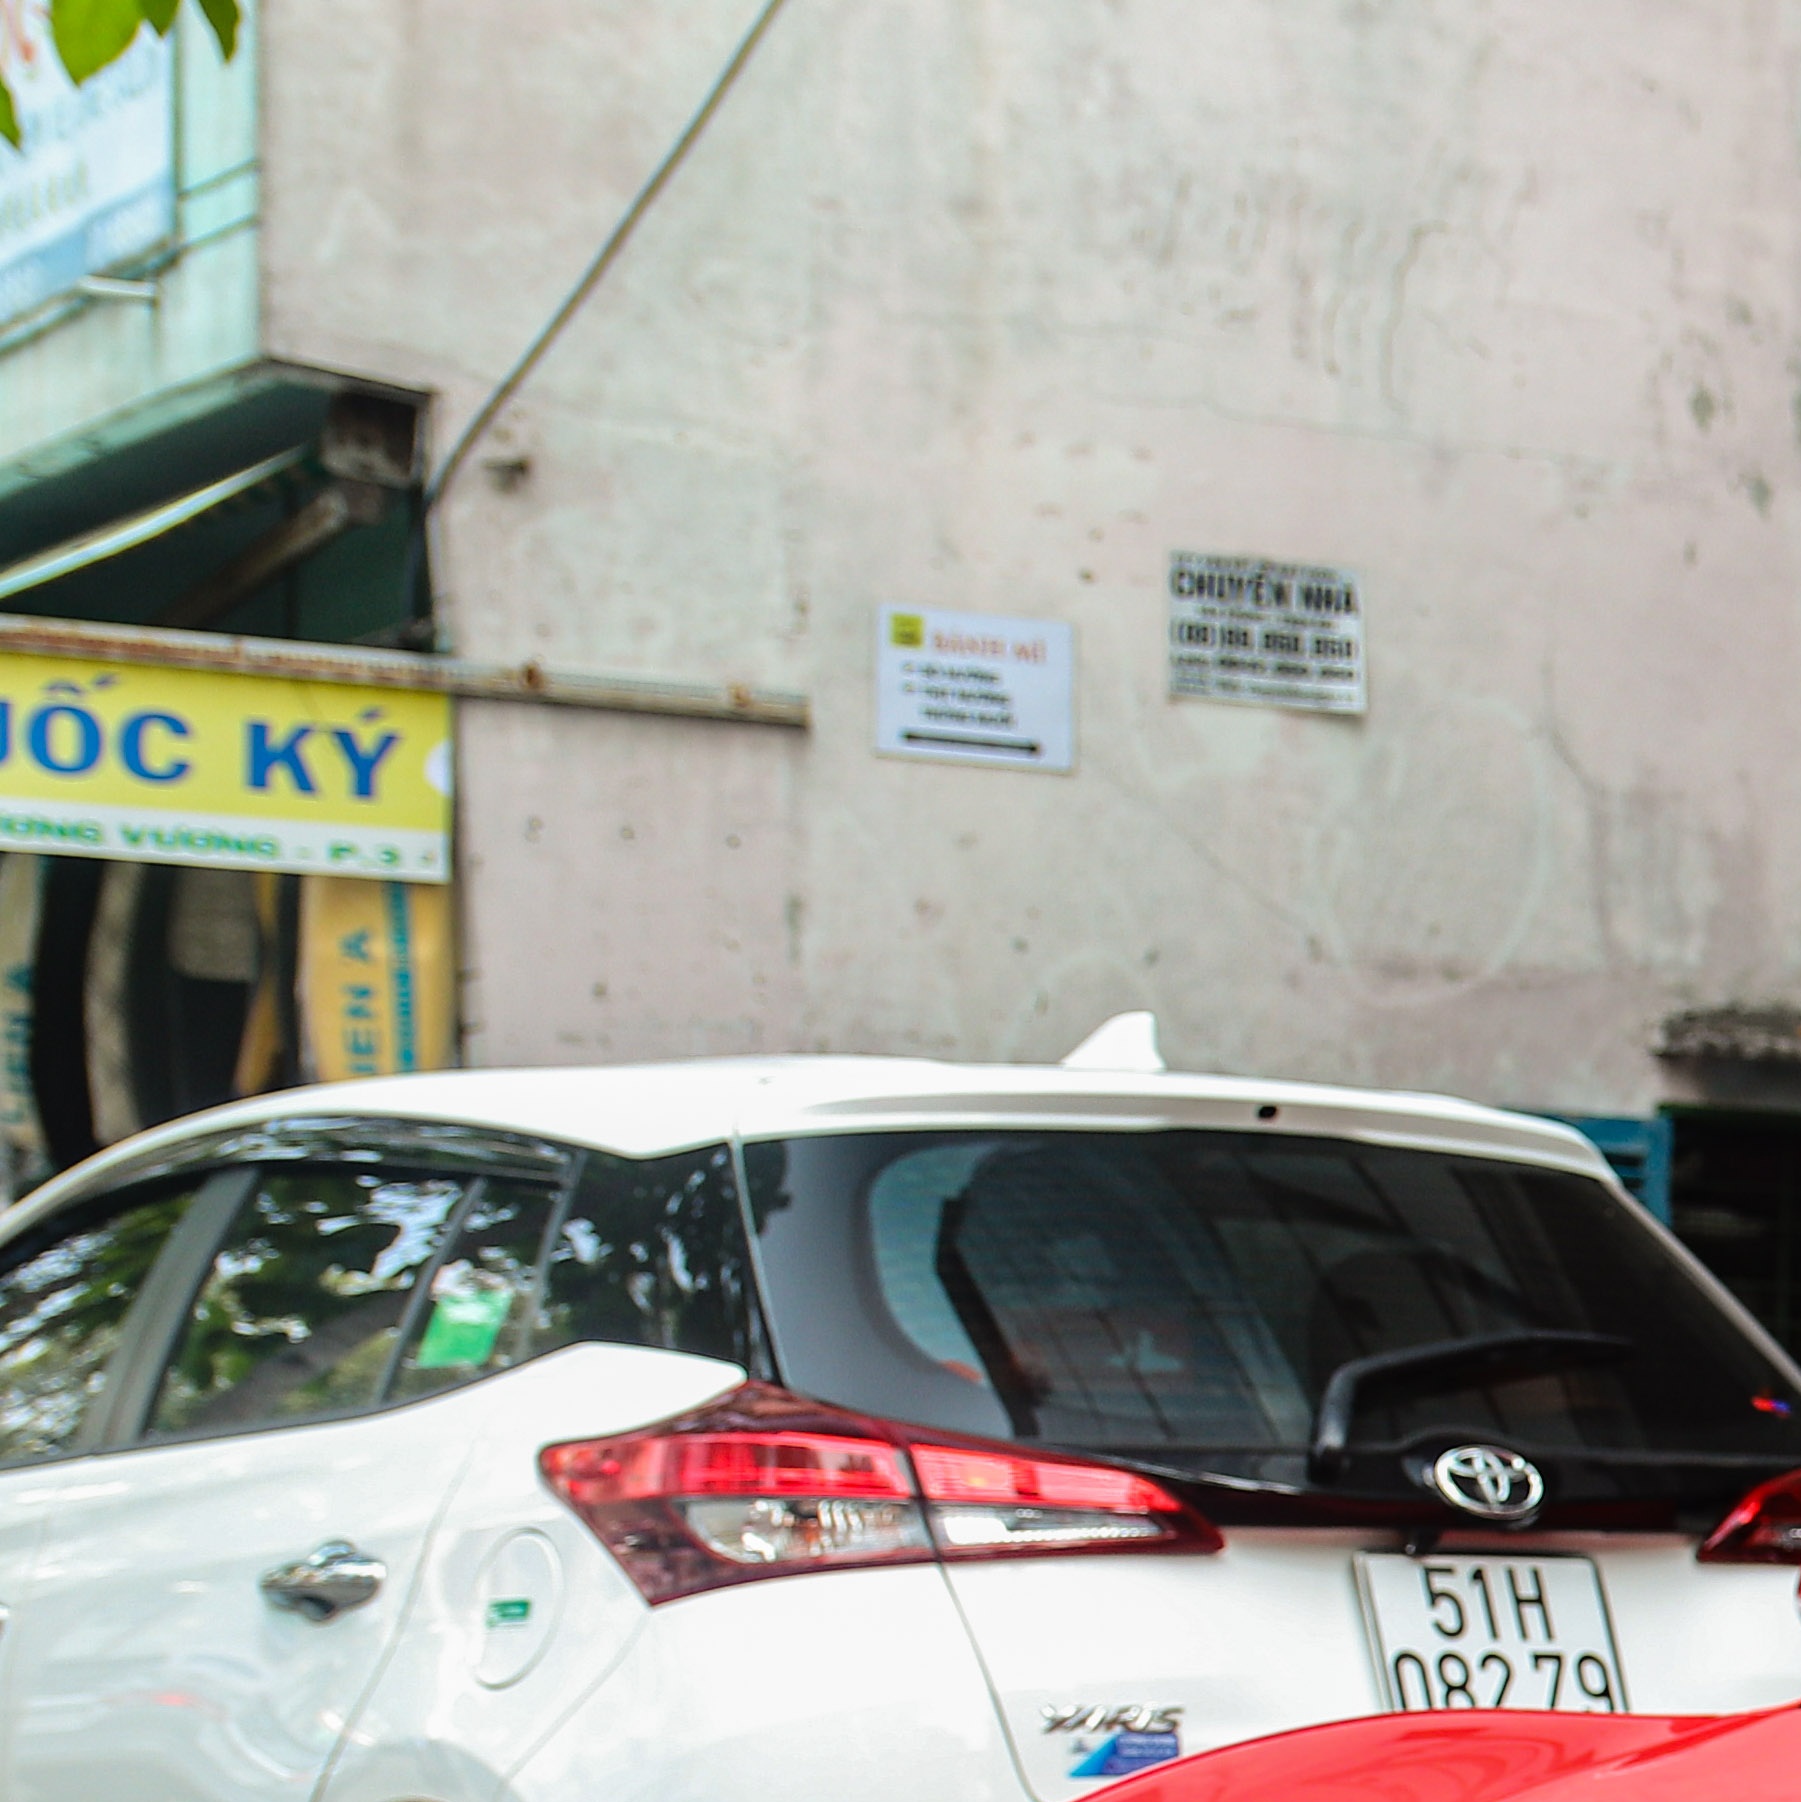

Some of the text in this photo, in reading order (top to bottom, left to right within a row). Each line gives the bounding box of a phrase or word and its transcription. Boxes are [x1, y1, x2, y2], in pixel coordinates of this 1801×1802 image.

[0, 673, 398, 798] ỐC KÝ
[1421, 1564, 1557, 1642] 51H
[1040, 1703, 1185, 1735] YARIS
